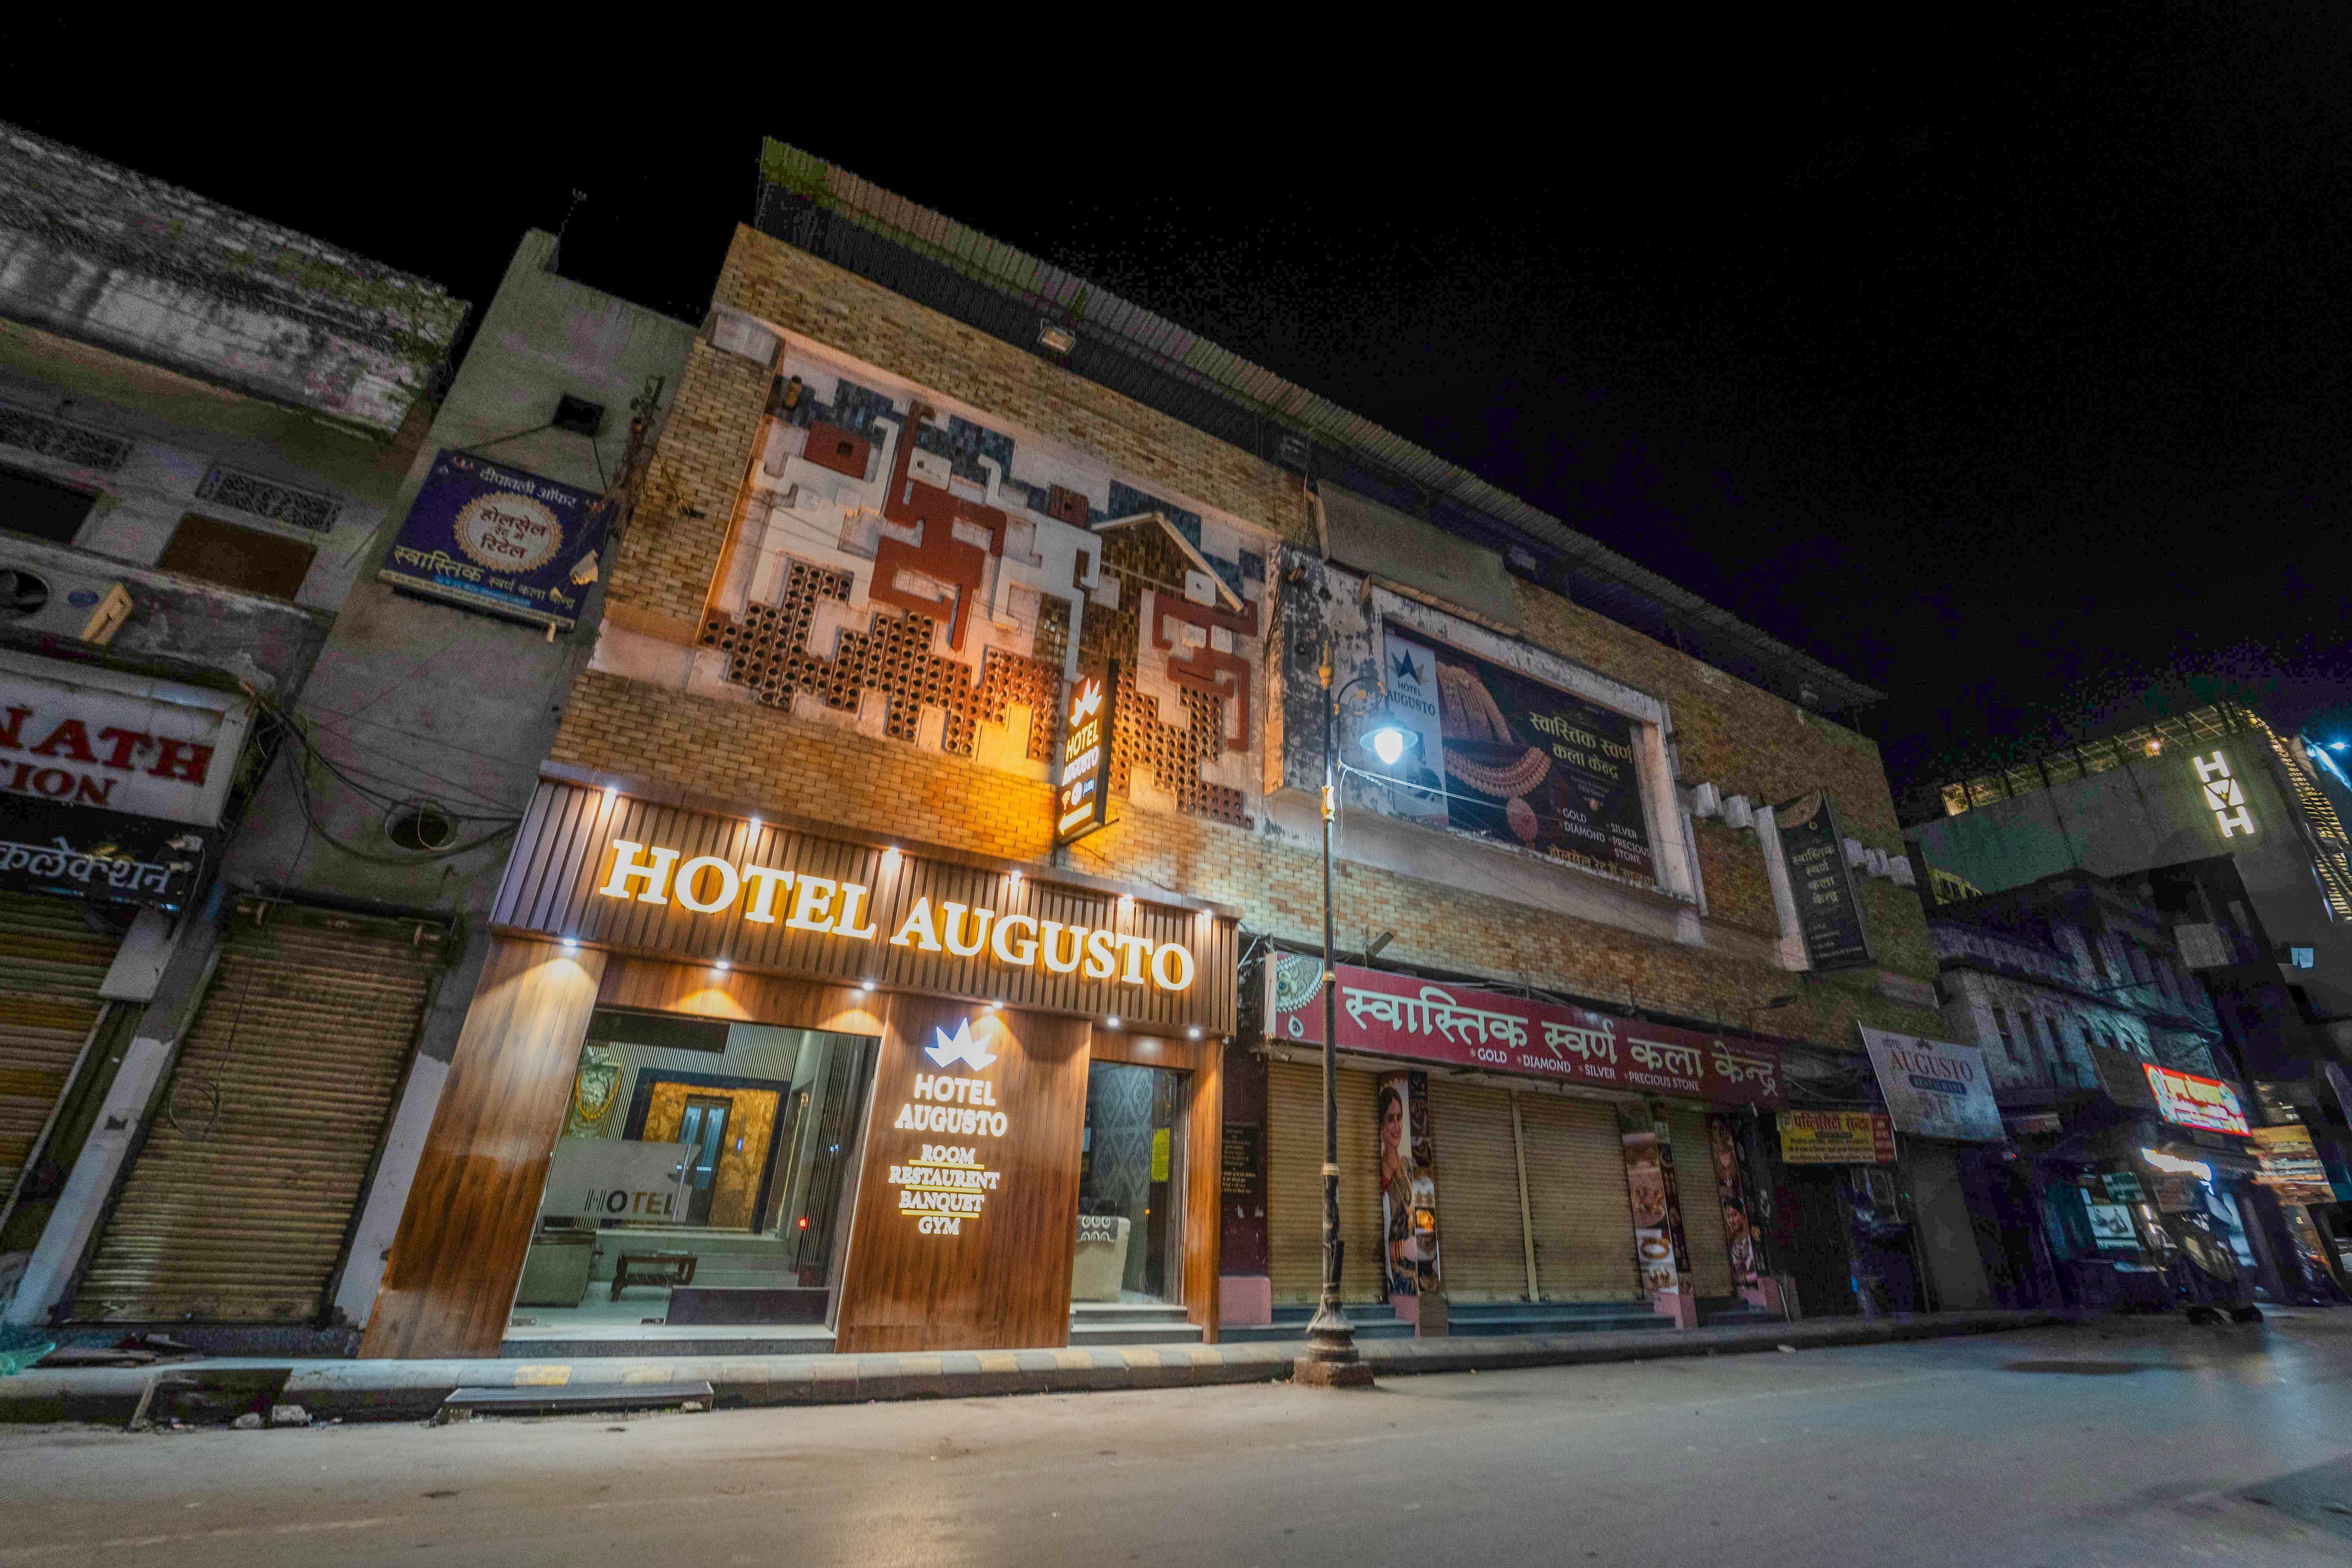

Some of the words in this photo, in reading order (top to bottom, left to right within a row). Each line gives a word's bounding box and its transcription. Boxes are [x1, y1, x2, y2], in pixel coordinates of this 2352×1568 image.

[481, 533, 528, 559] रिटेल
[394, 544, 486, 582] स्वास्तिक
[517, 584, 546, 601] कला
[1398, 681, 1422, 696] HOTEL
[1387, 690, 1436, 716] AUGUSTO
[1065, 718, 1099, 762] HOTEL
[1529, 711, 1597, 748] स्वास्तिक
[1062, 745, 1100, 787] AUGUSTO
[1552, 742, 1586, 767] कला
[0, 760, 117, 807] ION
[1562, 808, 1587, 823] GOLD
[1564, 821, 1606, 843] DIAMOND
[1610, 823, 1638, 840] SILVER
[1612, 836, 1651, 858] PRECIOUS
[1614, 848, 1642, 865] STONE
[599, 839, 877, 940] HOTEL
[890, 896, 1195, 991] AUGUSTO
[1342, 986, 1529, 1048] स्वास्तिक
[1541, 1019, 1618, 1065] स्वर्ण
[1627, 1036, 1704, 1079] कला
[1711, 1039, 1779, 1097] केन्द्र
[1478, 1047, 1507, 1064] GOLD
[1523, 1054, 1571, 1074] DIAMOND
[1585, 1064, 1616, 1080] SILVER
[1628, 1071, 1671, 1088] PRECIOUS
[1672, 1079, 1700, 1092] STONE
[1890, 1050, 1973, 1084] AUGUSTO
[914, 1073, 996, 1106] HOTEL
[894, 1103, 1007, 1137] AUGUSTO
[920, 1143, 976, 1165] ROOM
[888, 1165, 1000, 1190] RESTAURENT
[584, 1188, 674, 1215] HOTEL
[898, 1190, 985, 1214] BANQUET
[918, 1216, 961, 1236] GYM
